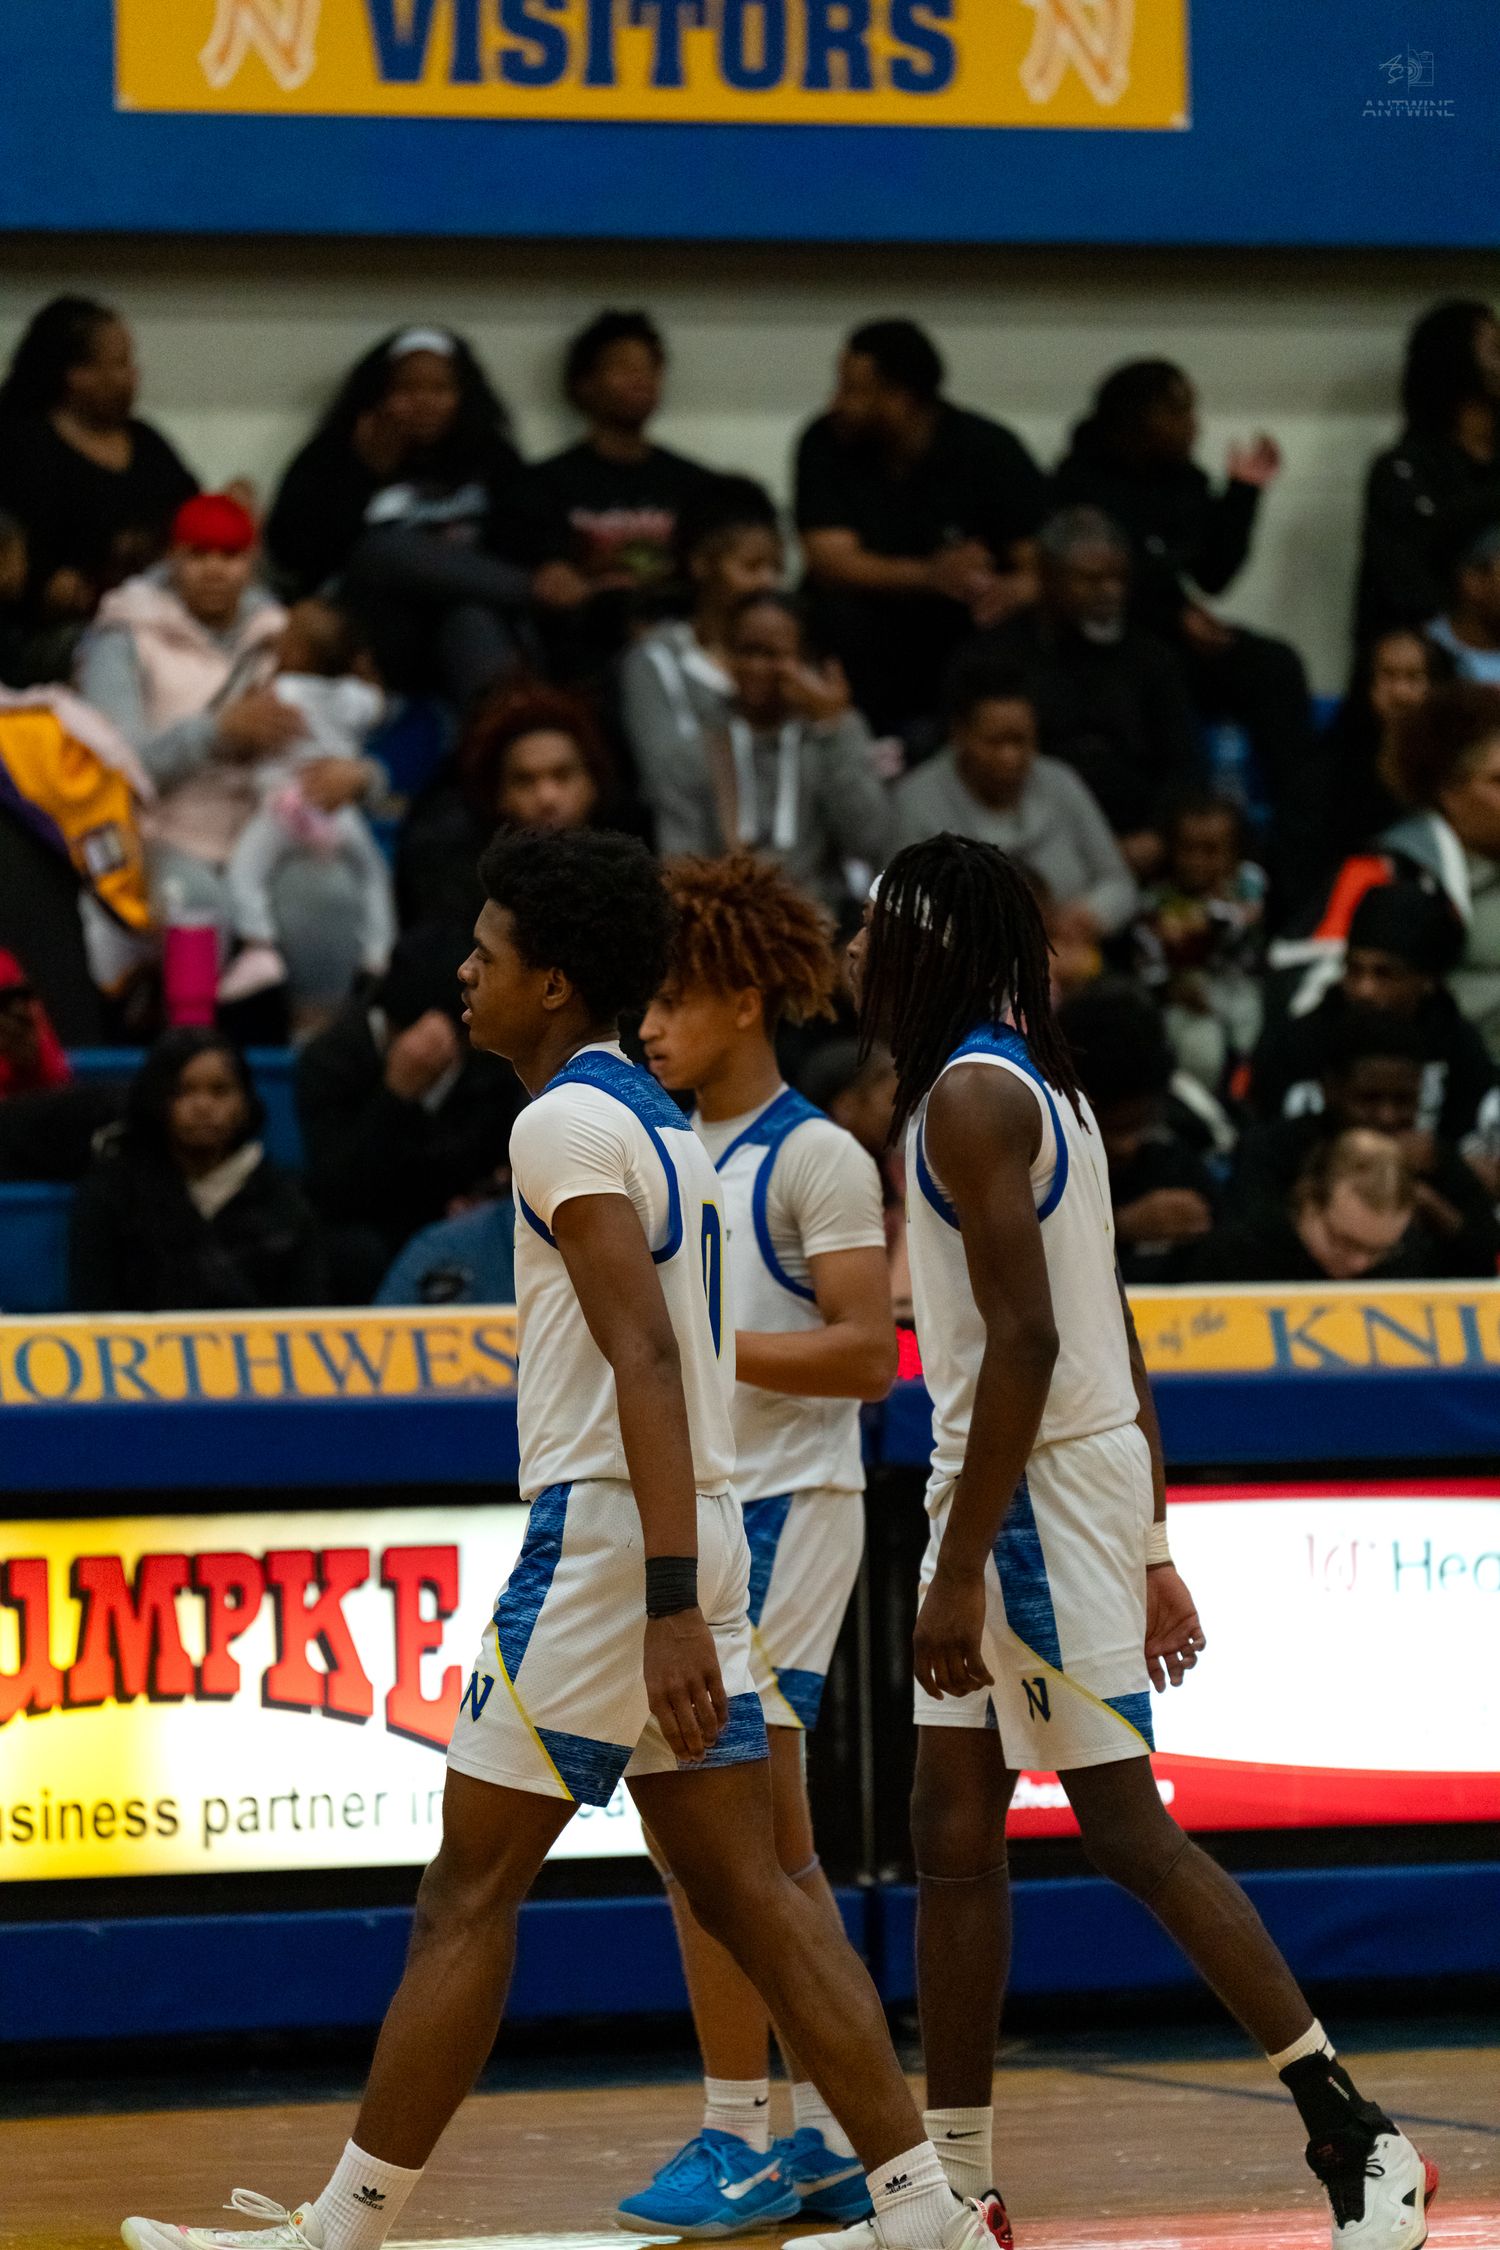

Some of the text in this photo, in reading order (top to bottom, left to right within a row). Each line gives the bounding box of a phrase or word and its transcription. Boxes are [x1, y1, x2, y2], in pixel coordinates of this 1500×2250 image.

[366, 0, 958, 94] VISITORS
[0, 1322, 518, 1402] ORTHWES
[1266, 1303, 1500, 1370] KNI
[460, 1670, 494, 1722] N
[1021, 1677, 1051, 1723] N
[0, 1788, 180, 1843] siness
[203, 1786, 388, 1850] partner
[353, 2193, 384, 2211] adidas
